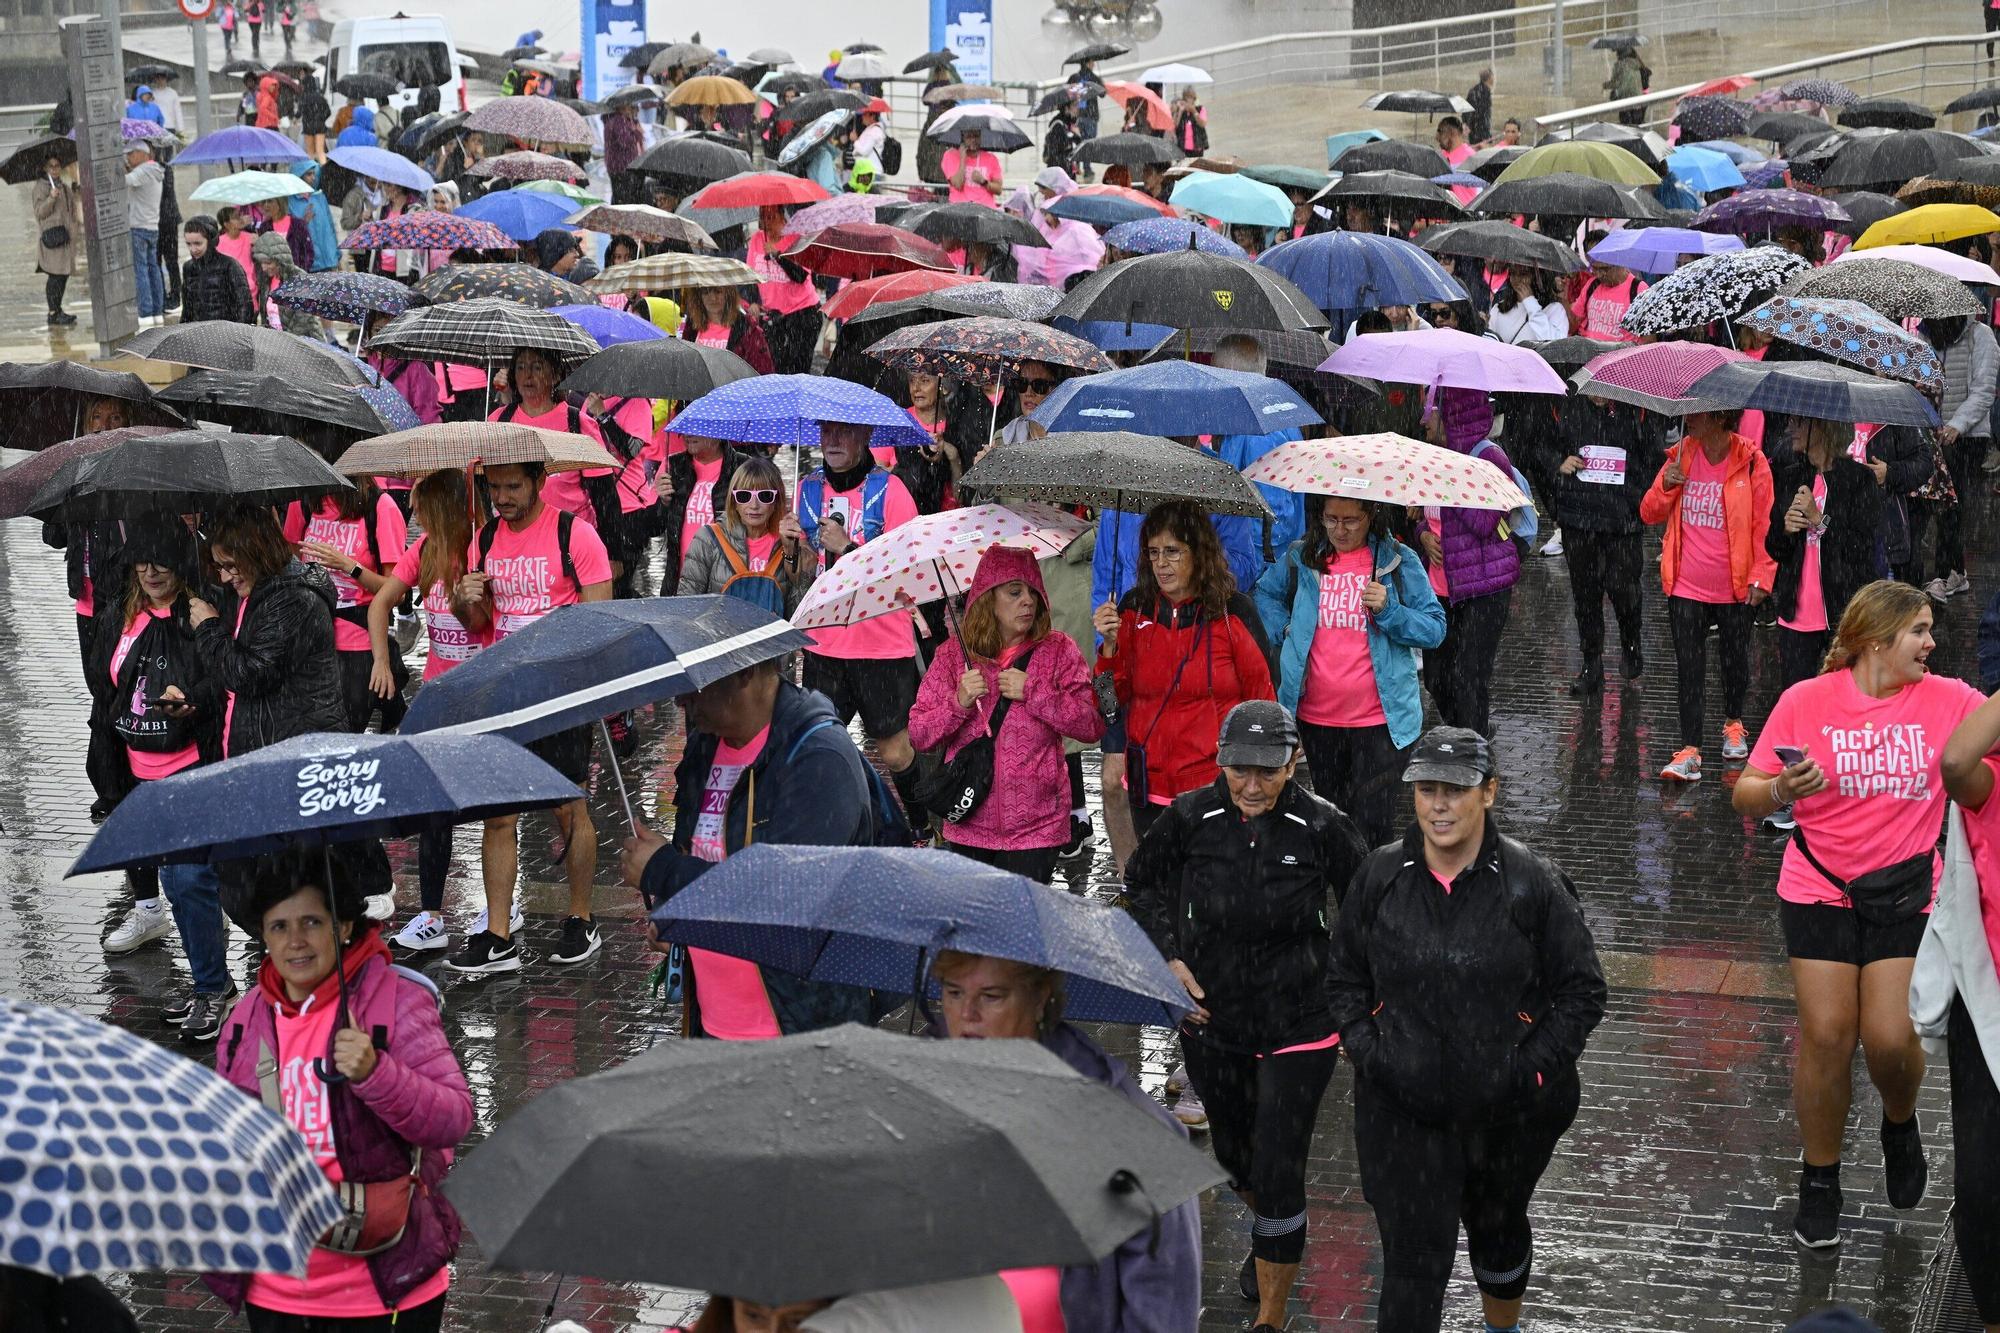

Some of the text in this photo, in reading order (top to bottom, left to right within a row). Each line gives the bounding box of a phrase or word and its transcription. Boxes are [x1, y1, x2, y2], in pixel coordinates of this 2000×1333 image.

[1586, 458, 1616, 470] 2025
[433, 628, 468, 644] 2025
[297, 759, 380, 788] Sorry
[327, 777, 358, 790] NOT
[299, 783, 387, 817] Sorry
[947, 786, 975, 823] adidas
